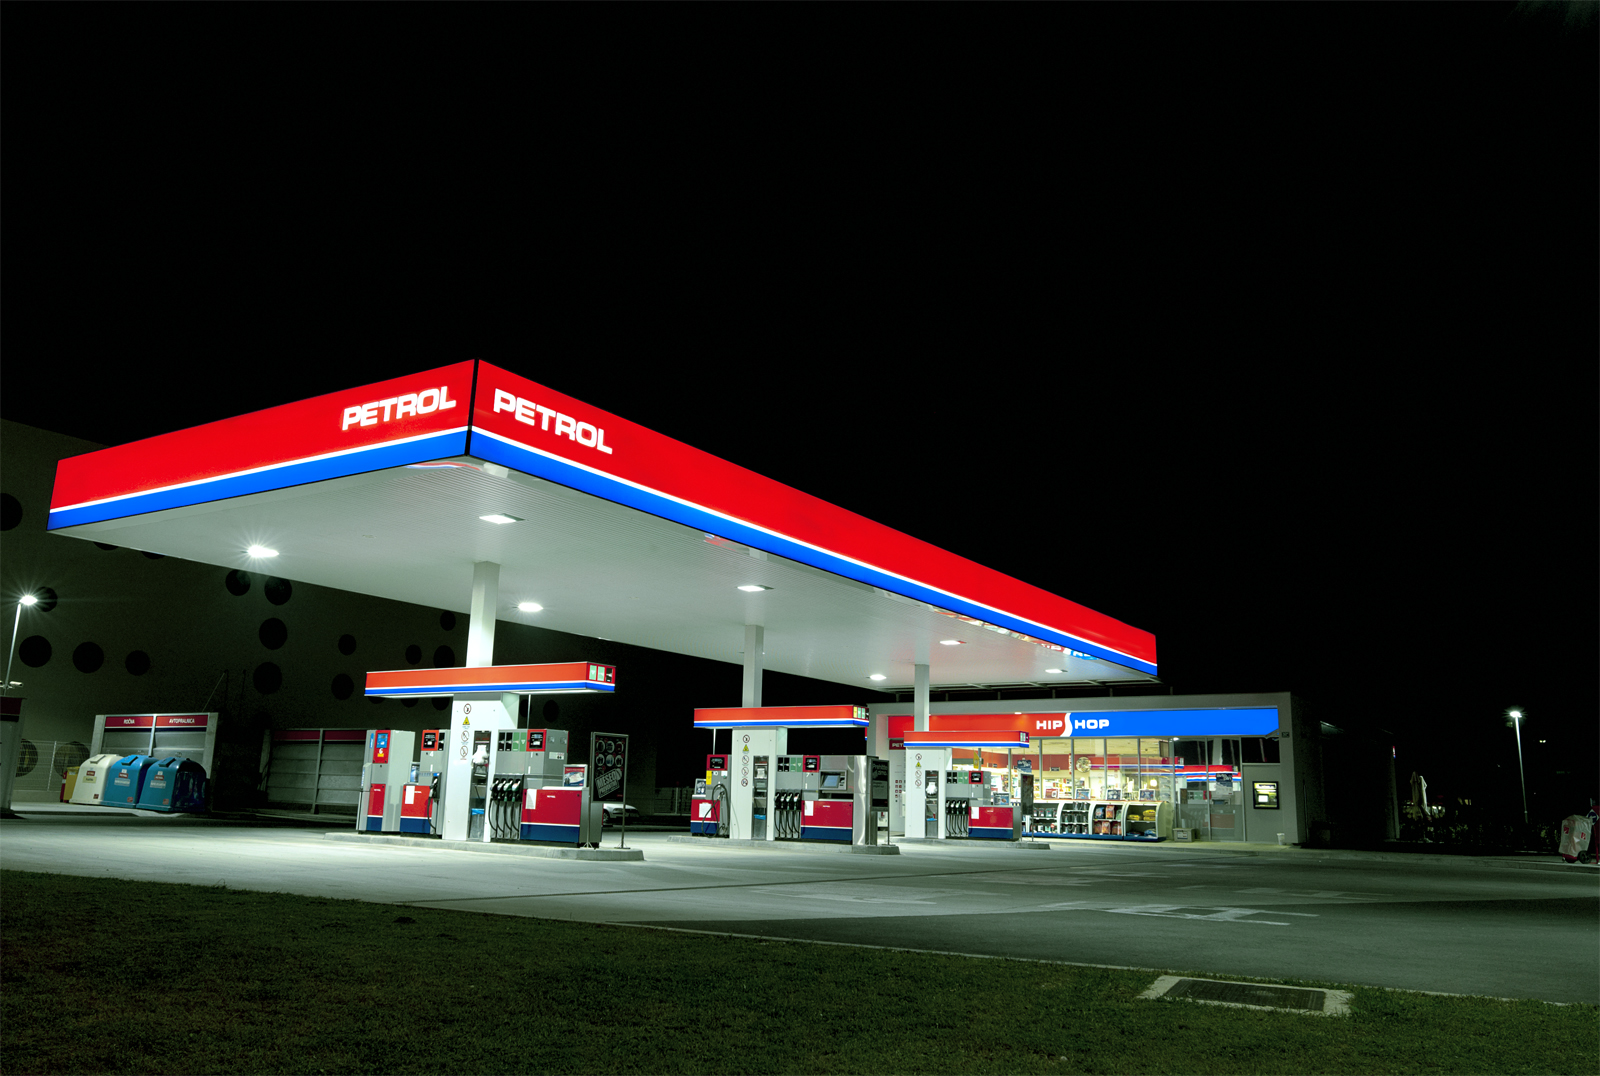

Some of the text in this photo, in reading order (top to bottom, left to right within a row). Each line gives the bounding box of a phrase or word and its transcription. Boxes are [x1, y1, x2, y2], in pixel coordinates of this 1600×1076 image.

[342, 386, 457, 431] PETROL
[493, 388, 613, 455] PETROL
[1036, 720, 1063, 730] HIP
